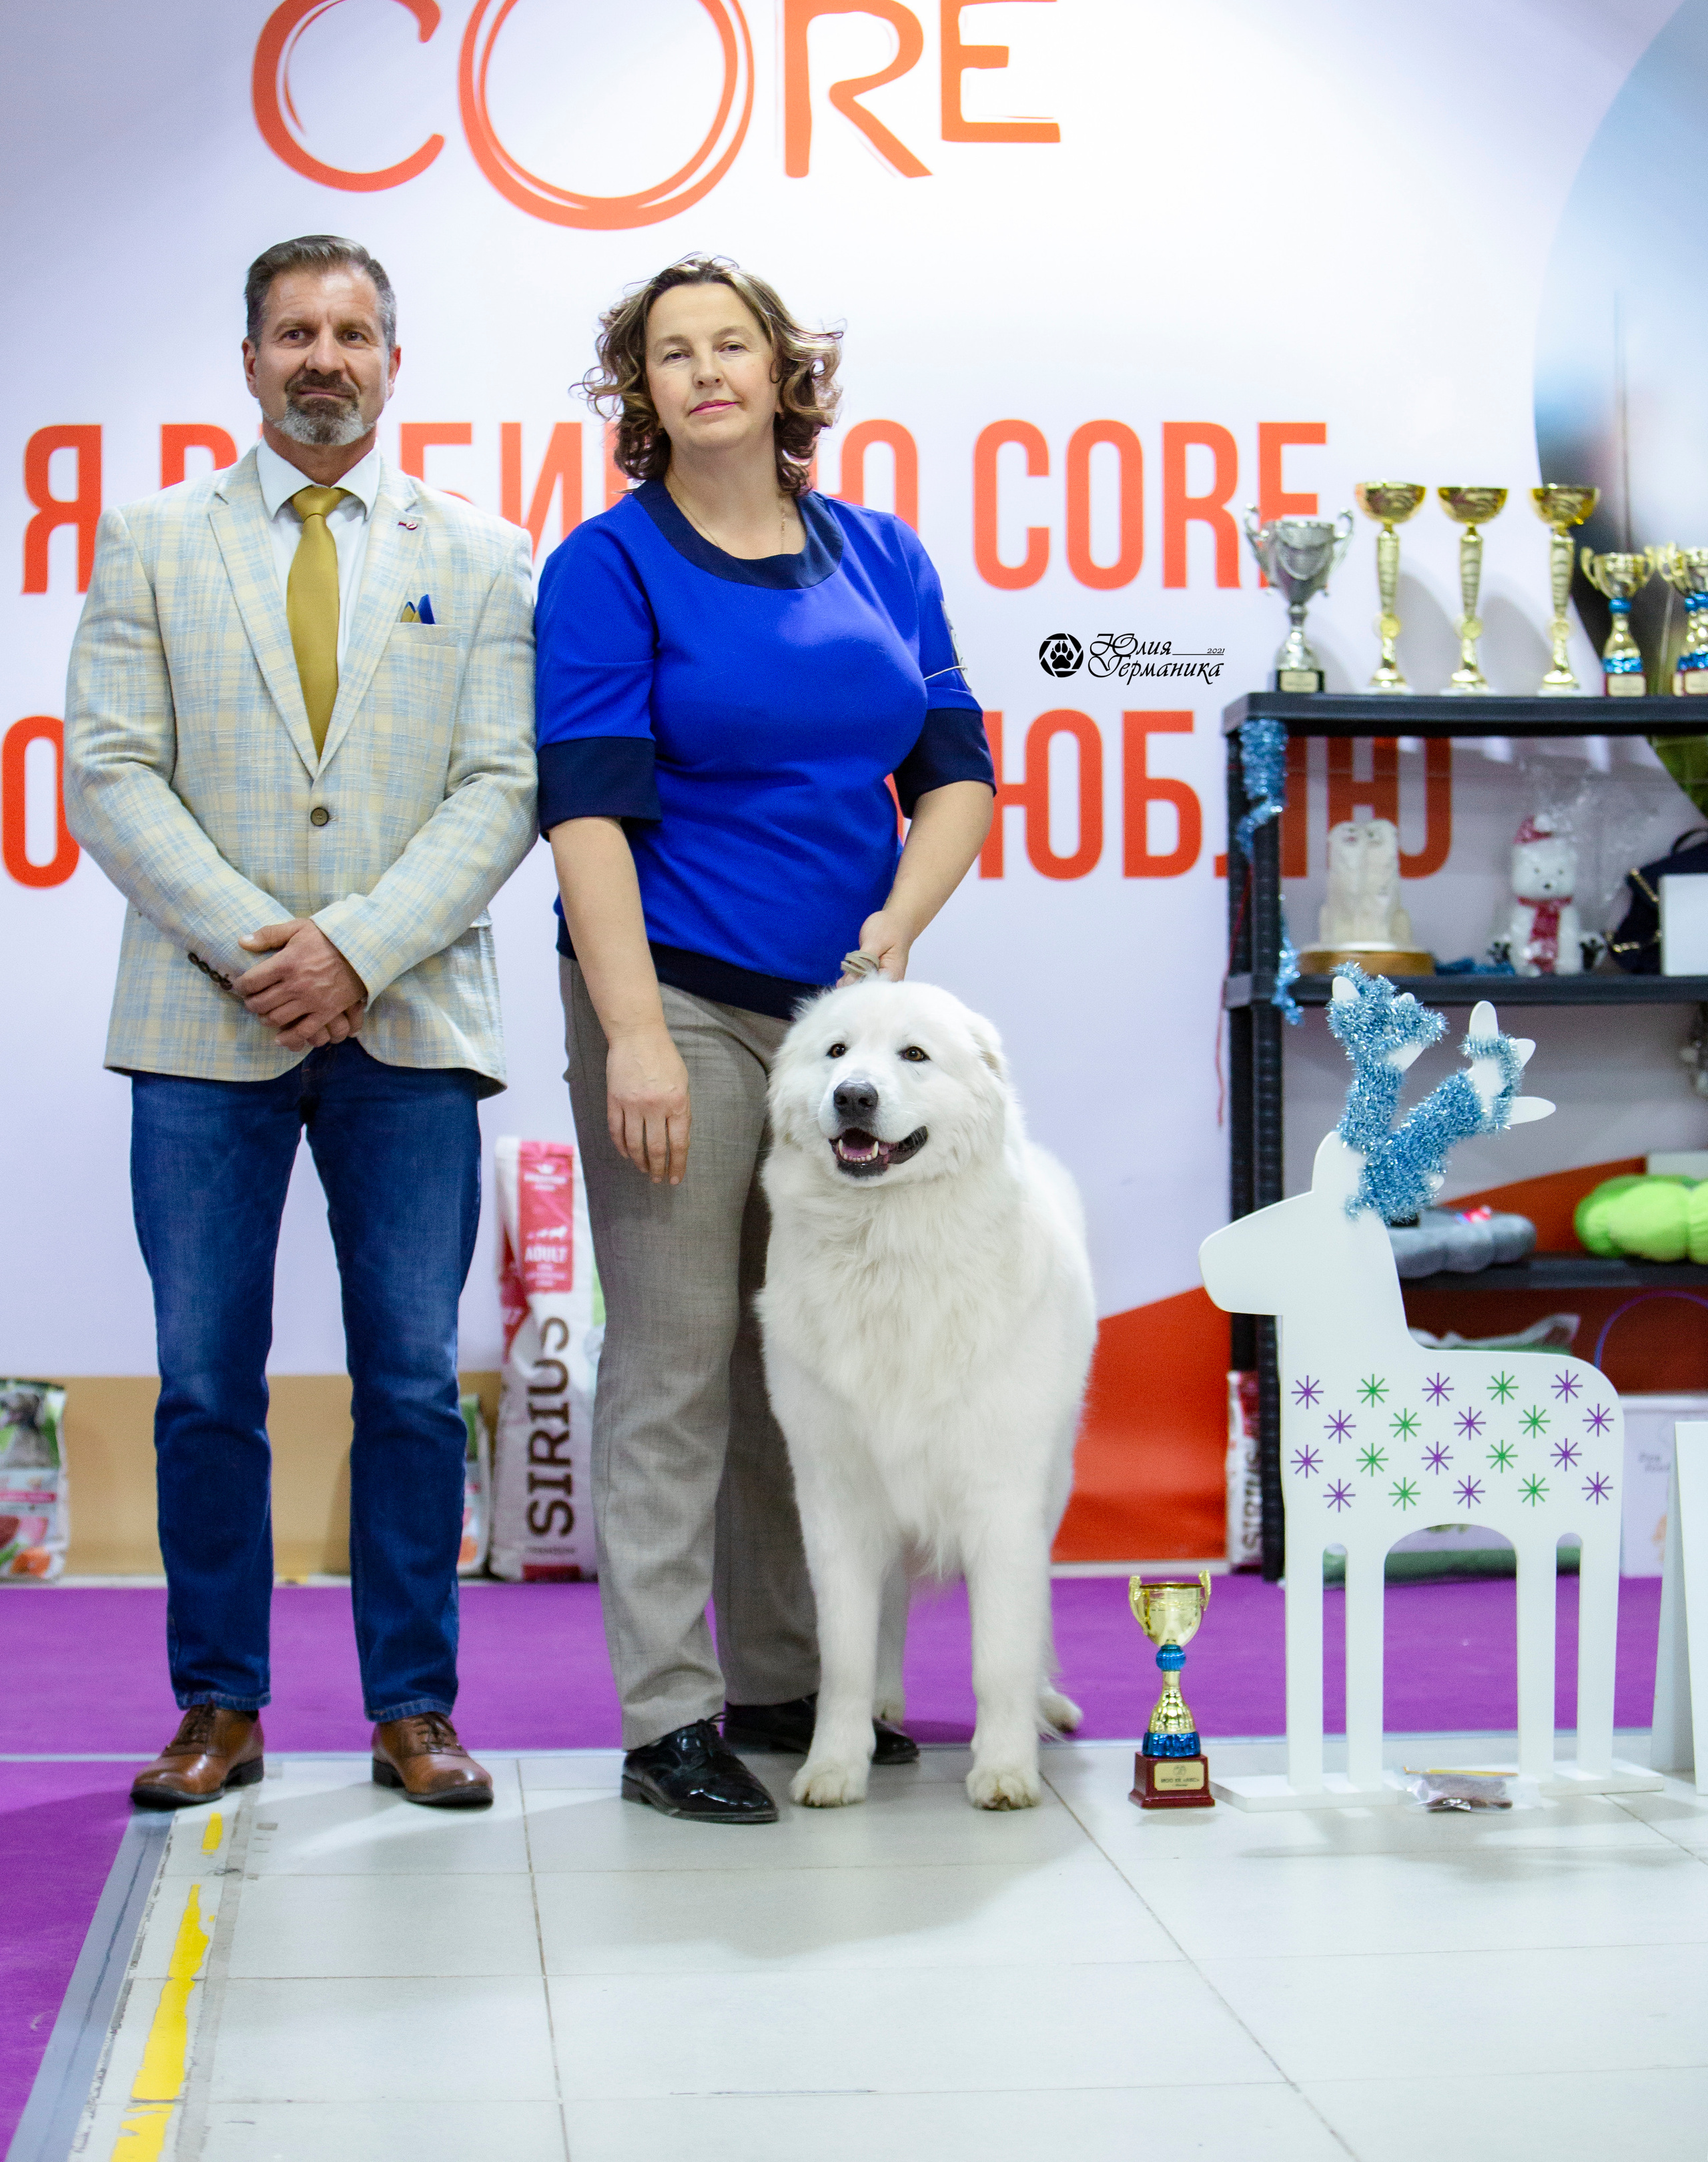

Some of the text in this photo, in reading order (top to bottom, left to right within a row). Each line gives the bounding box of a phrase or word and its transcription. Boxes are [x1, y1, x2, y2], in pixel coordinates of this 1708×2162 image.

[252, 0, 1061, 231] CORE
[21, 423, 103, 594] Я
[972, 418, 1328, 591] CORE
[884, 708, 1452, 882] ЮБЮ
[524, 1244, 567, 1263] ADULT
[526, 1317, 575, 1537] SIRIUS
